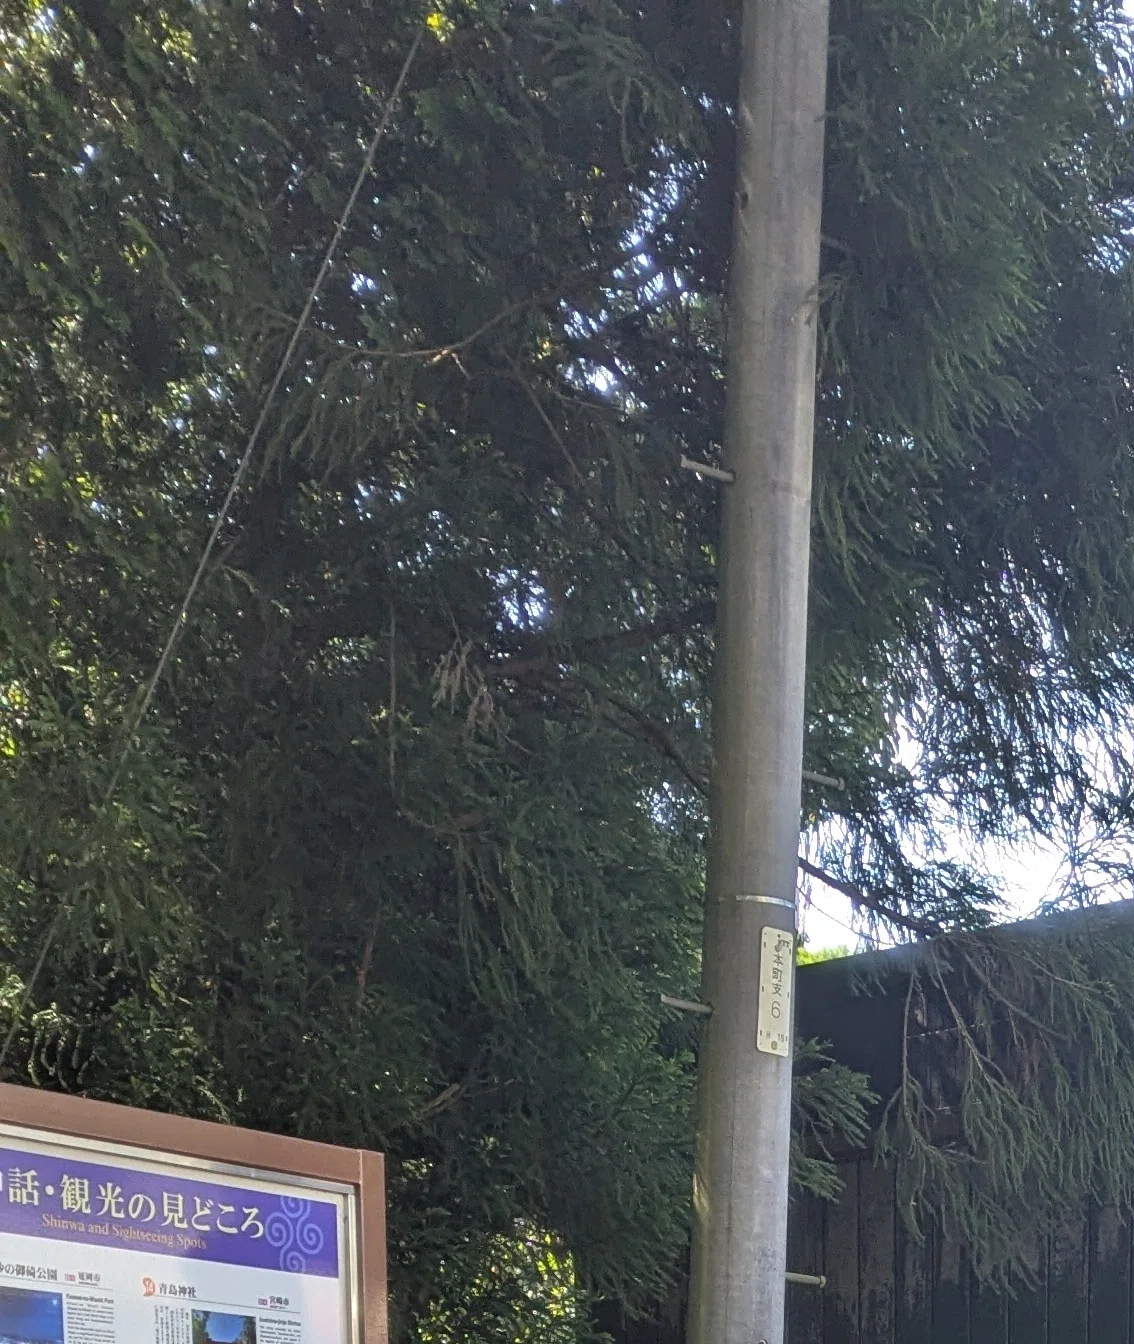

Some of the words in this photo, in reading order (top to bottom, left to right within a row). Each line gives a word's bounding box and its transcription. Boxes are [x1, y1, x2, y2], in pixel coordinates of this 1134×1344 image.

[0, 1167, 265, 1239] 話・観光の見どころ
[41, 1213, 86, 1233] Shinwa
[88, 1220, 109, 1236] and
[112, 1224, 174, 1247] Sightseeing
[176, 1232, 207, 1250] Spots
[159, 1282, 197, 1299] 青島神社
